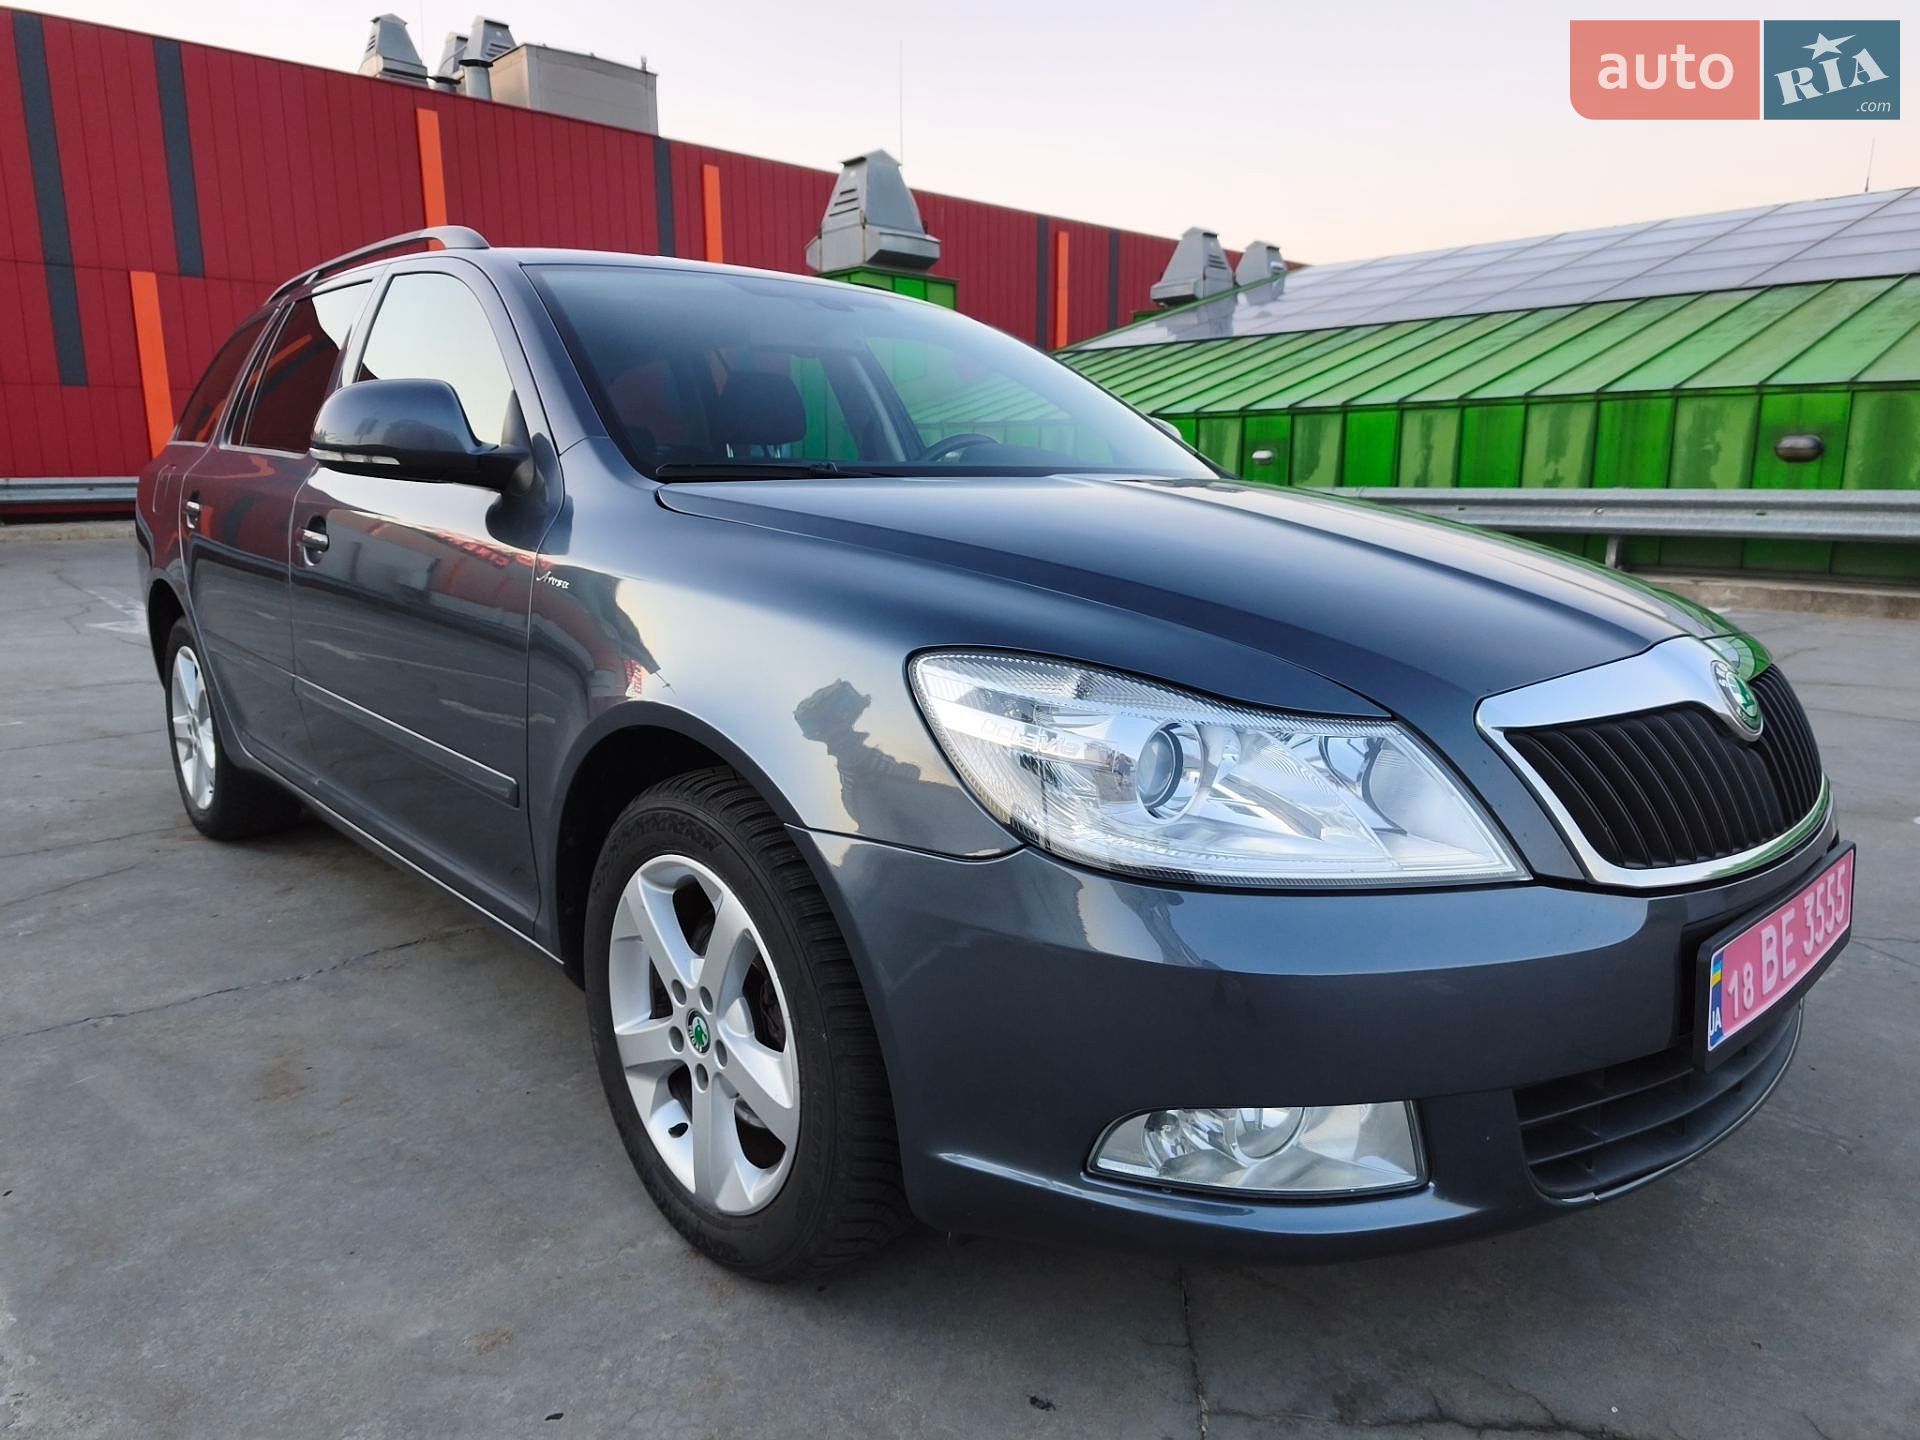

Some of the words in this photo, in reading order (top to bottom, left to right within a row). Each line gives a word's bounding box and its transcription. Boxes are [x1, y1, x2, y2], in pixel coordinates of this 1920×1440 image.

[1726, 961, 1754, 1019] 18
[1761, 906, 1797, 996] BE
[1803, 863, 1846, 956] 3555
